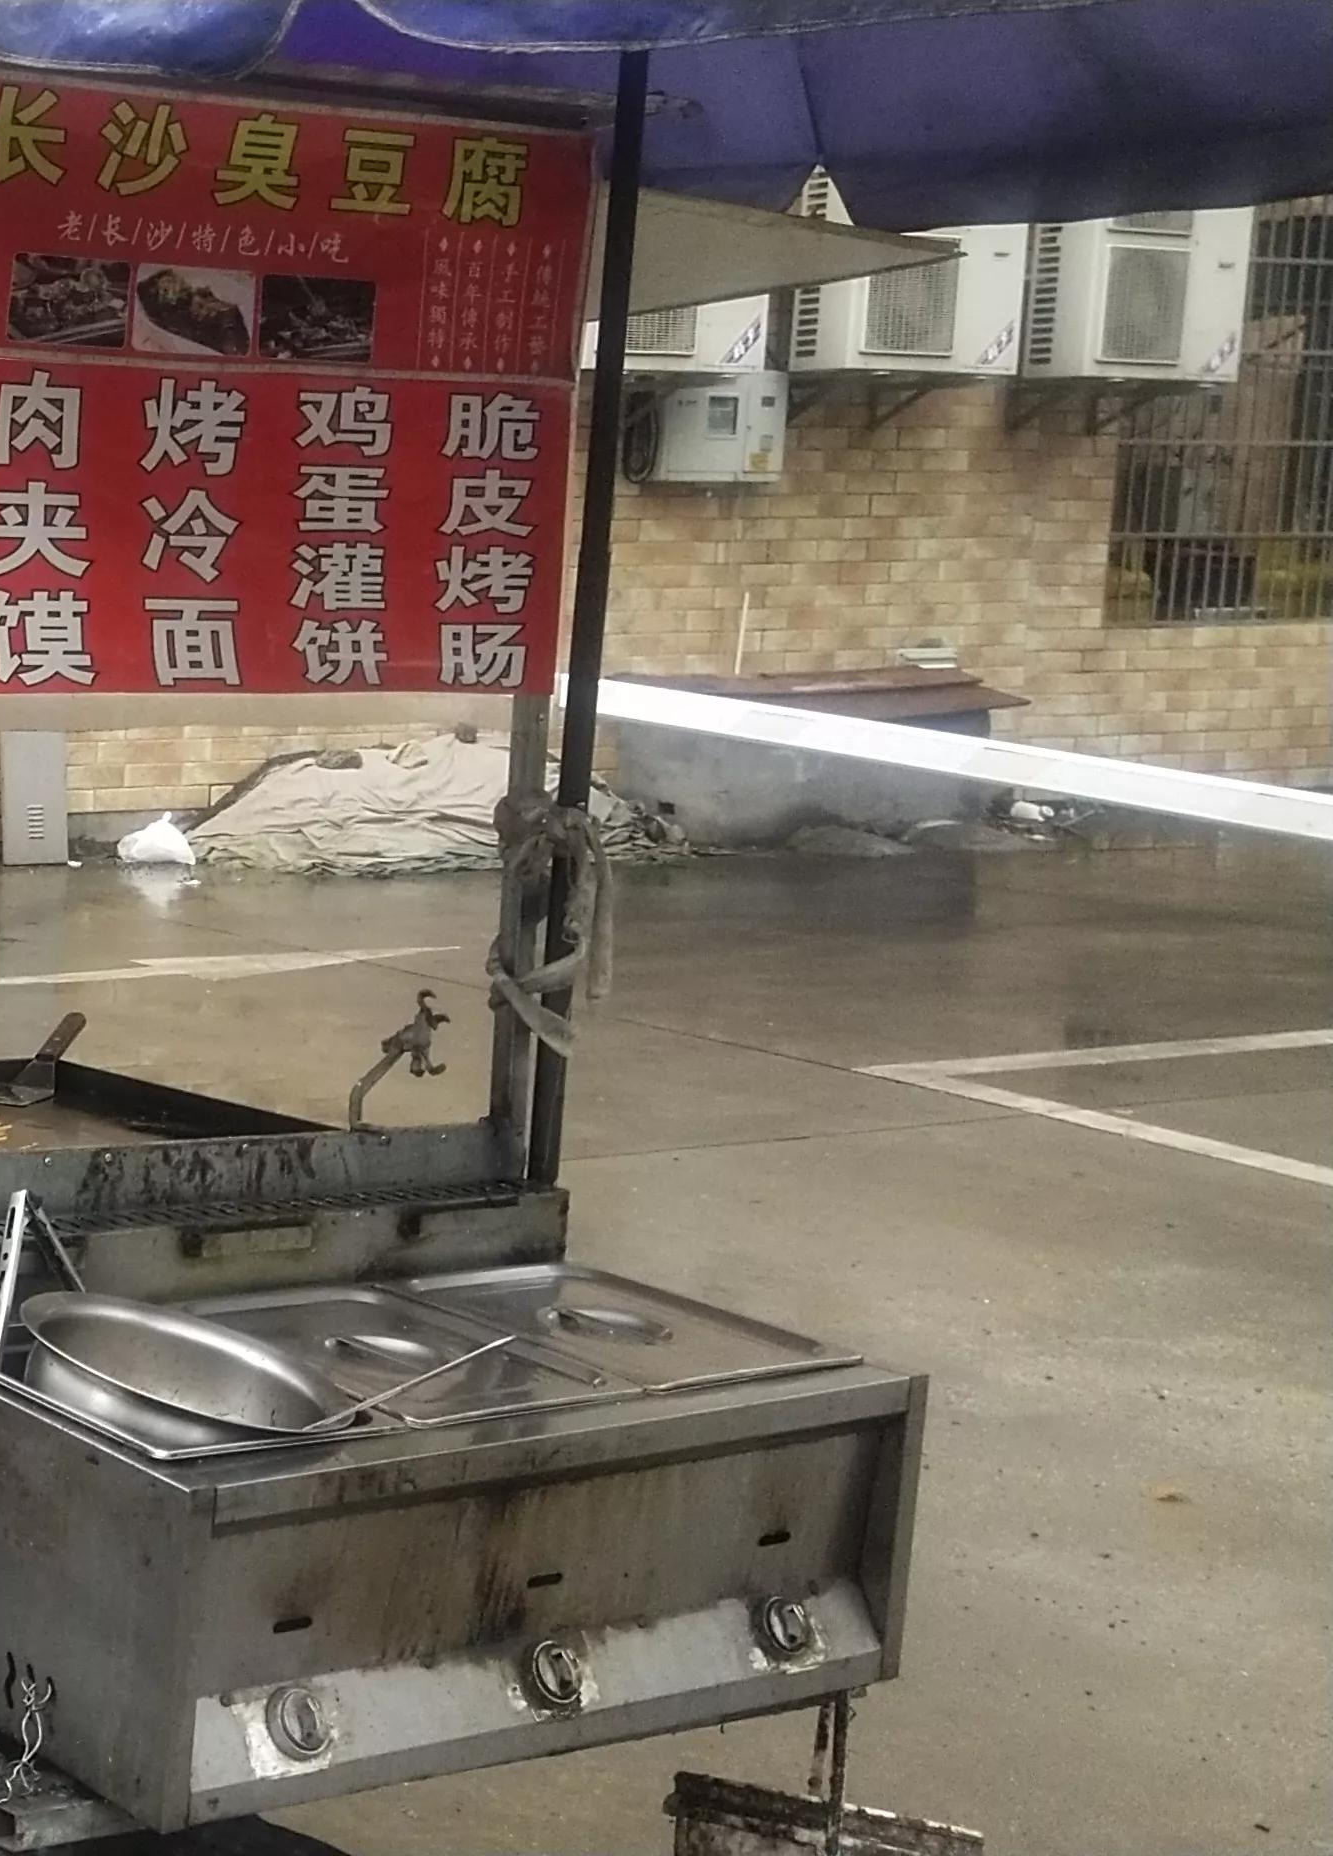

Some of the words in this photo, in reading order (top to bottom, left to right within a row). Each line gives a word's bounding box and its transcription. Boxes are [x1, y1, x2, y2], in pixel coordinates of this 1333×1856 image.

[139, 377, 247, 689] 烤冷面
[289, 387, 394, 689] 鸡蛋灌饼
[435, 391, 542, 690] 脆皮烤肠
